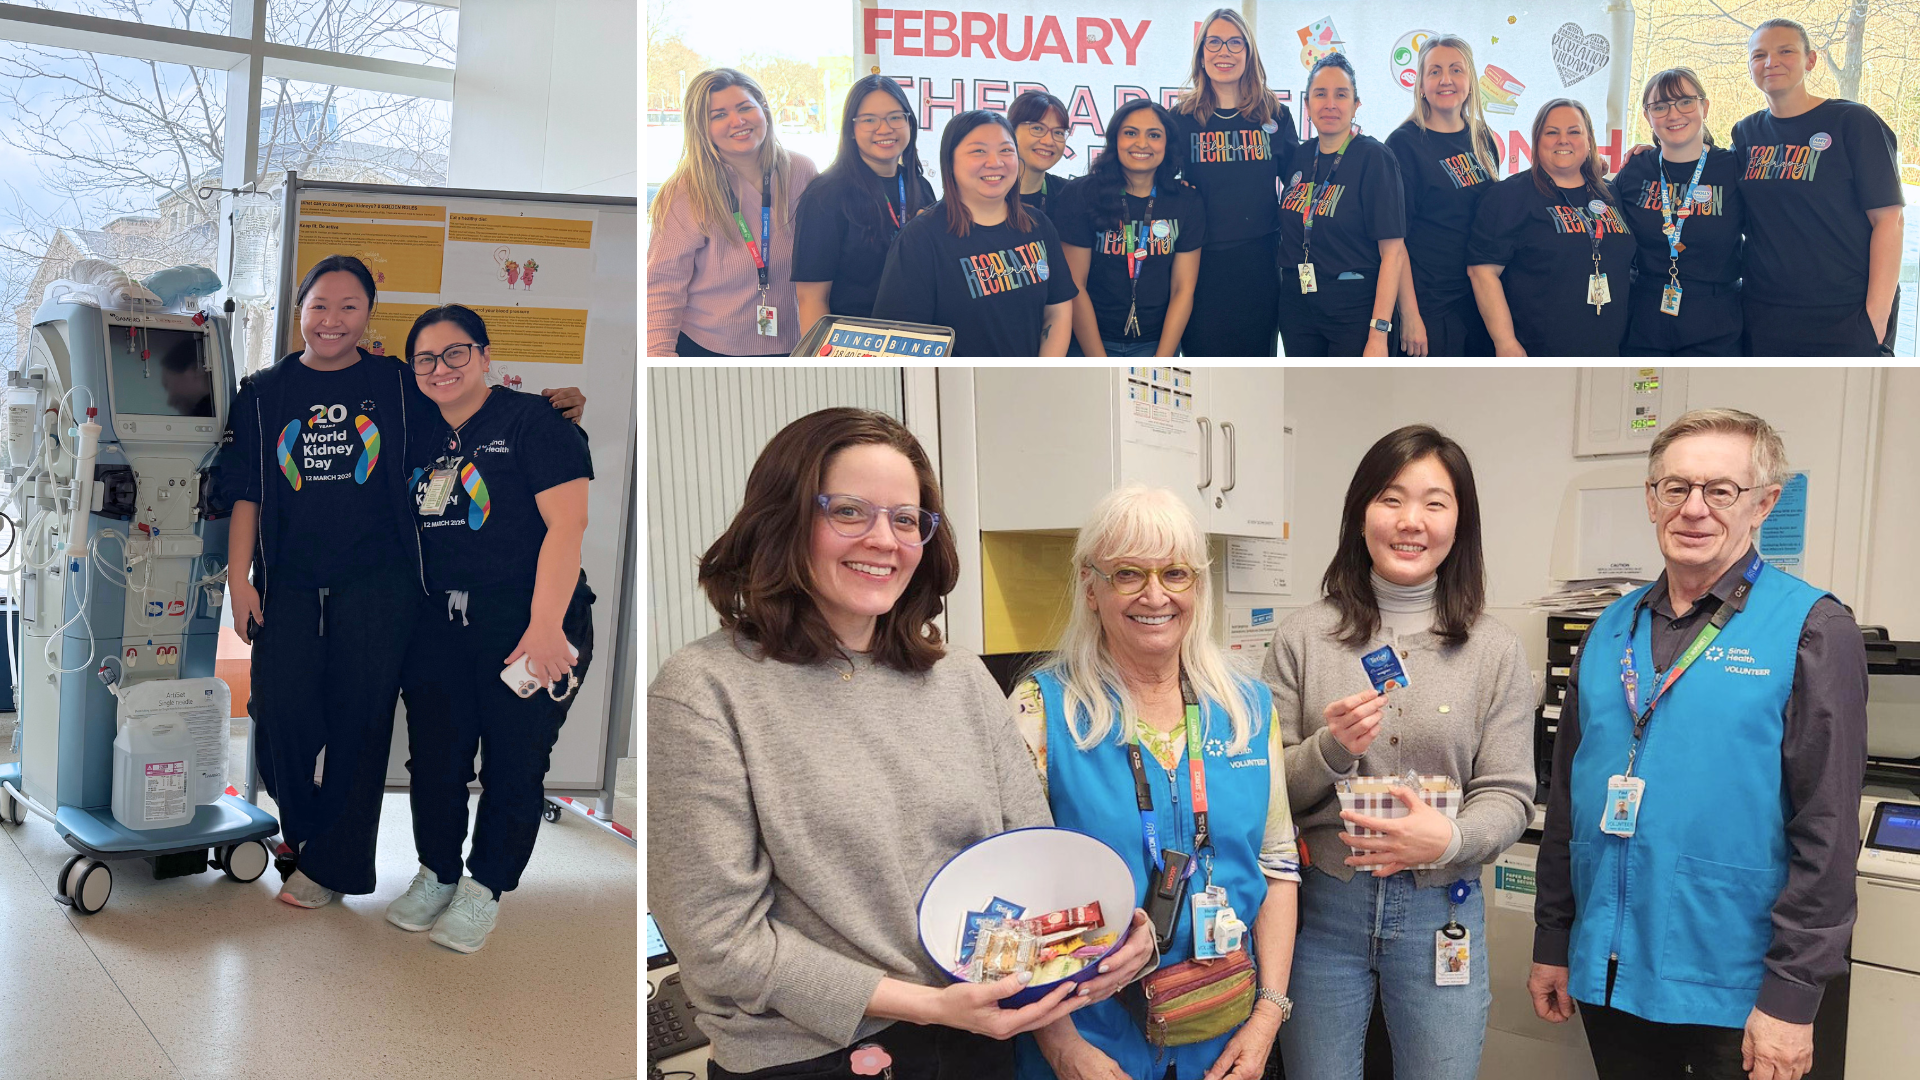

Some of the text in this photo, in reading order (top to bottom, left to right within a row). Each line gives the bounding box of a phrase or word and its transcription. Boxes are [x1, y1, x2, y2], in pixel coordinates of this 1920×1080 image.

[863, 7, 1152, 66] FEBRUARY
[1552, 34, 1610, 67] RECREATION
[1553, 48, 1594, 76] THERAPY
[1190, 130, 1272, 163] RECREATION
[1196, 140, 1266, 154] therapy
[959, 240, 1048, 299] RECREATION
[971, 261, 1037, 282] therap
[832, 333, 944, 356] BINGO BINGO
[308, 404, 348, 429] 20
[302, 430, 347, 444] World
[303, 444, 354, 456] Kidney
[304, 458, 332, 470] Day
[1725, 665, 1771, 676] VOLUNTEER
[1726, 654, 1755, 664] Health
[1190, 718, 1198, 742] HUMANITY
[1166, 866, 1176, 890] ascom
